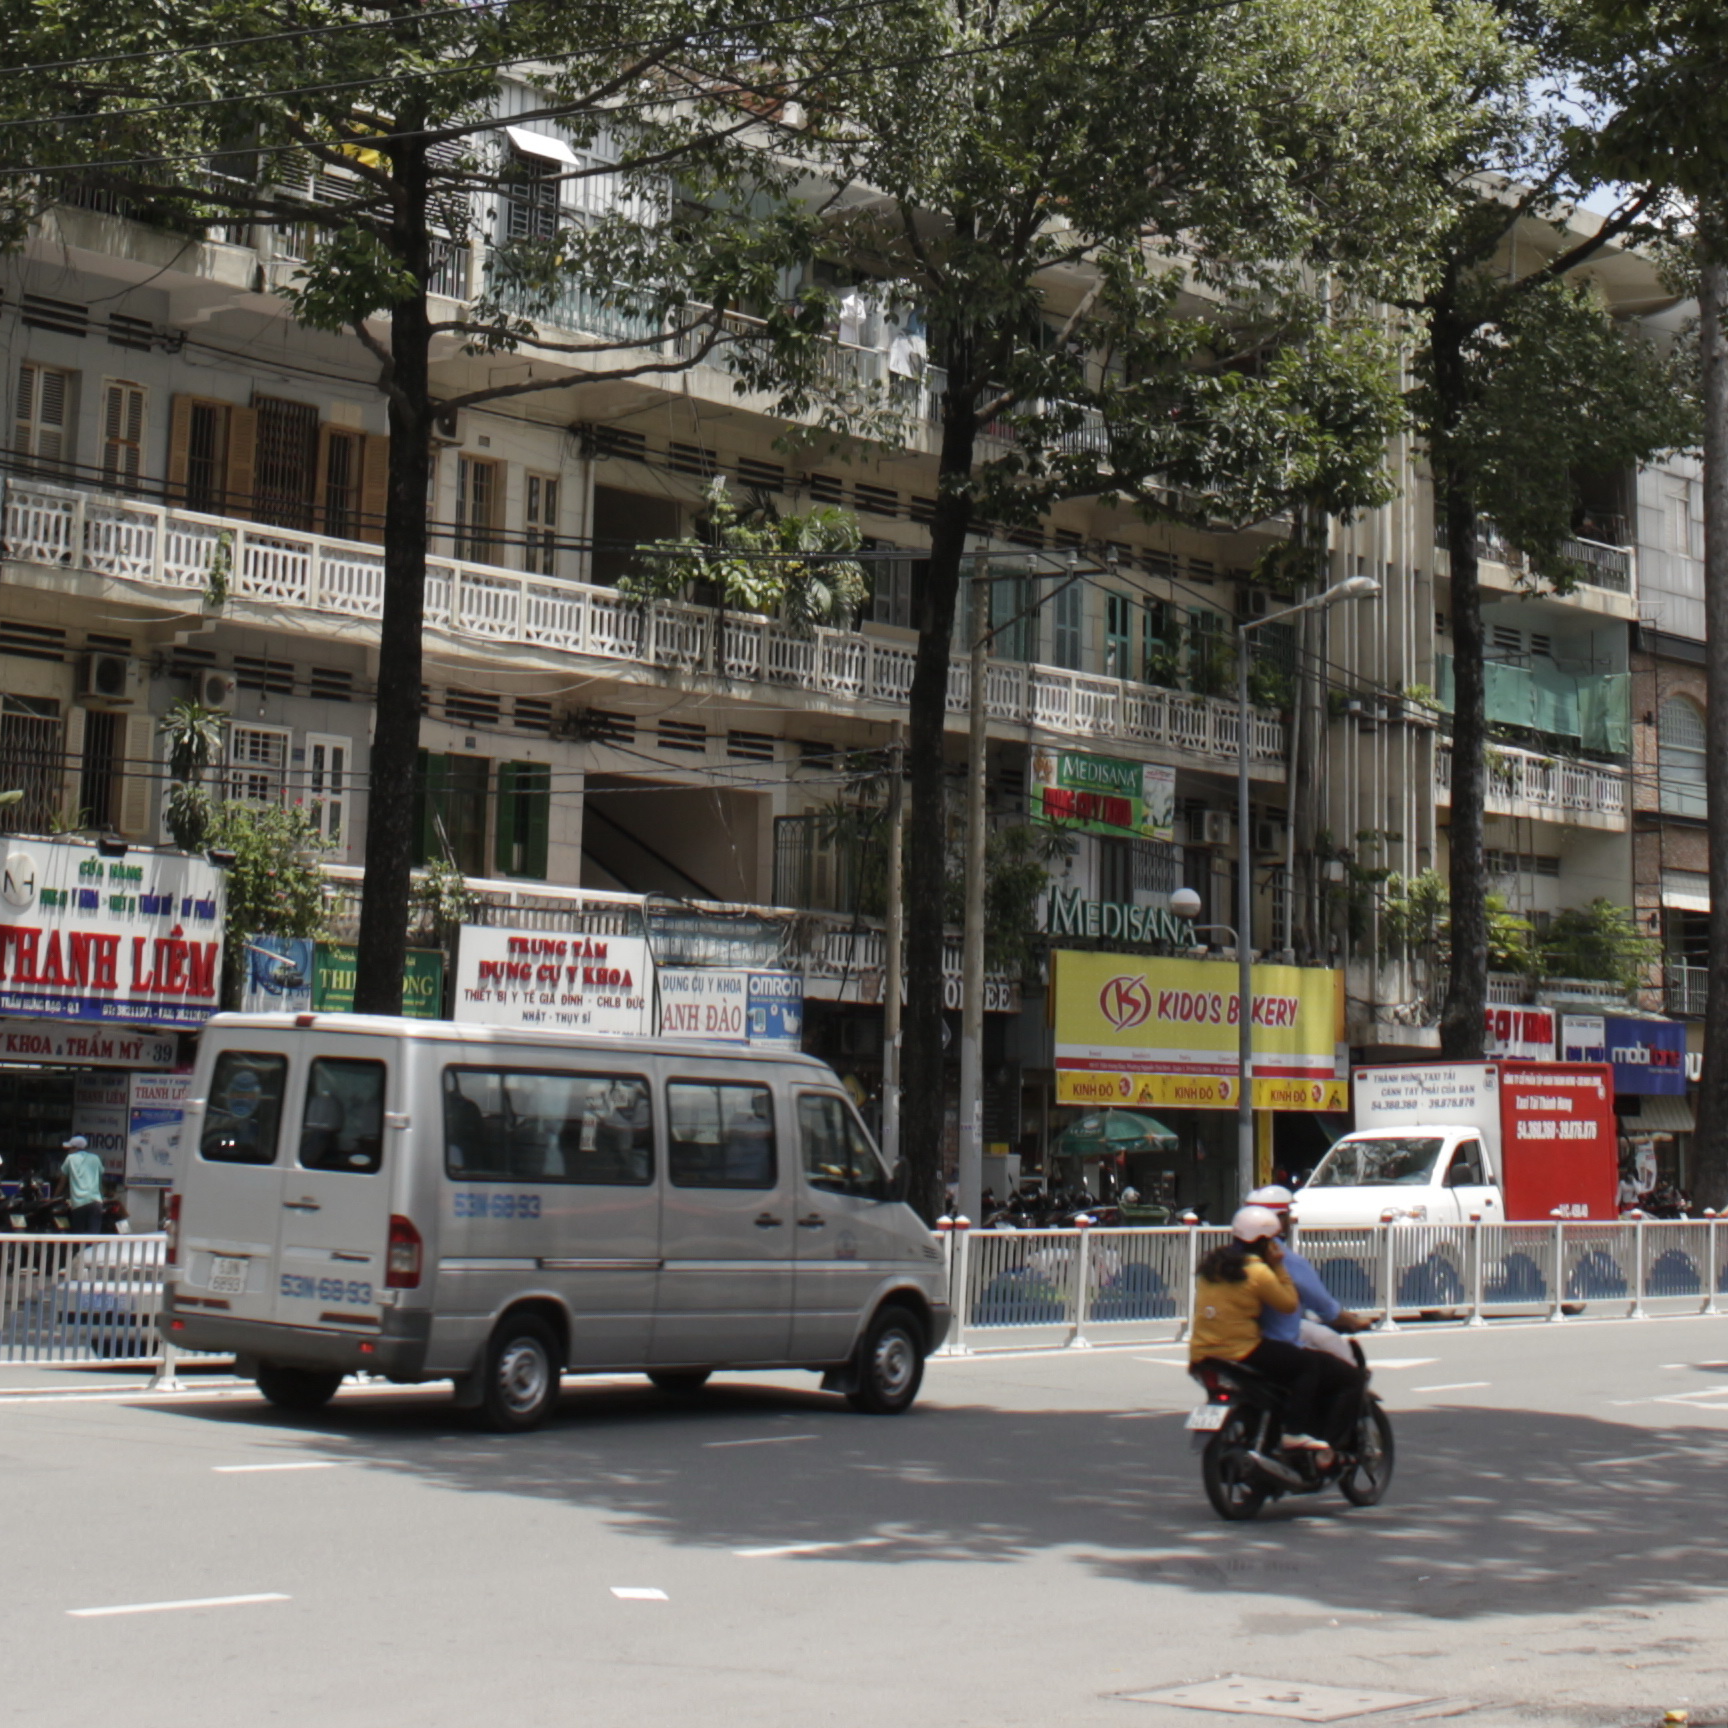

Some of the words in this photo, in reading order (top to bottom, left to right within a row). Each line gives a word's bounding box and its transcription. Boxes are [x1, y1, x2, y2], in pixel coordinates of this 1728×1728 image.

[1063, 756, 1136, 787] MEDISANA
[1050, 885, 1198, 947] MEDISANA
[508, 937, 567, 957] TRUNG
[572, 937, 607, 959] TÂM
[130, 924, 218, 998] LIÊM
[479, 960, 532, 984] DỤNG
[536, 964, 561, 986] CỤ
[566, 966, 578, 983] Y
[583, 967, 633, 987] KHOA
[663, 976, 688, 994] DỤNG
[692, 975, 704, 995] CỤ
[717, 977, 741, 993] KHOA
[464, 985, 491, 1002] THIẾT
[497, 991, 507, 1006] BỊ
[524, 989, 535, 1003] TẾ
[561, 990, 583, 1006] ĐÌNH
[597, 996, 621, 1008] CHLB
[626, 993, 645, 1009] ĐỨC
[749, 977, 801, 996] OMRON
[662, 1003, 700, 1031] ANH
[706, 998, 741, 1032] ĐÀO
[1158, 991, 1222, 1025] KIDO'S
[1227, 995, 1298, 1027] BKERY
[7, 1034, 52, 1054] KHOA
[66, 1031, 113, 1059] THẨM
[119, 1037, 144, 1060] MỸ
[152, 1044, 172, 1062] 39
[1612, 1042, 1681, 1067] mobifone
[136, 1087, 169, 1100] THANH
[1073, 1083, 1096, 1096] KINH
[1099, 1081, 1113, 1097] ĐÔ
[1175, 1086, 1197, 1099] KINH
[1200, 1084, 1213, 1100] ĐÔ
[1271, 1090, 1291, 1102] KINH
[1293, 1088, 1306, 1102] ĐÔ
